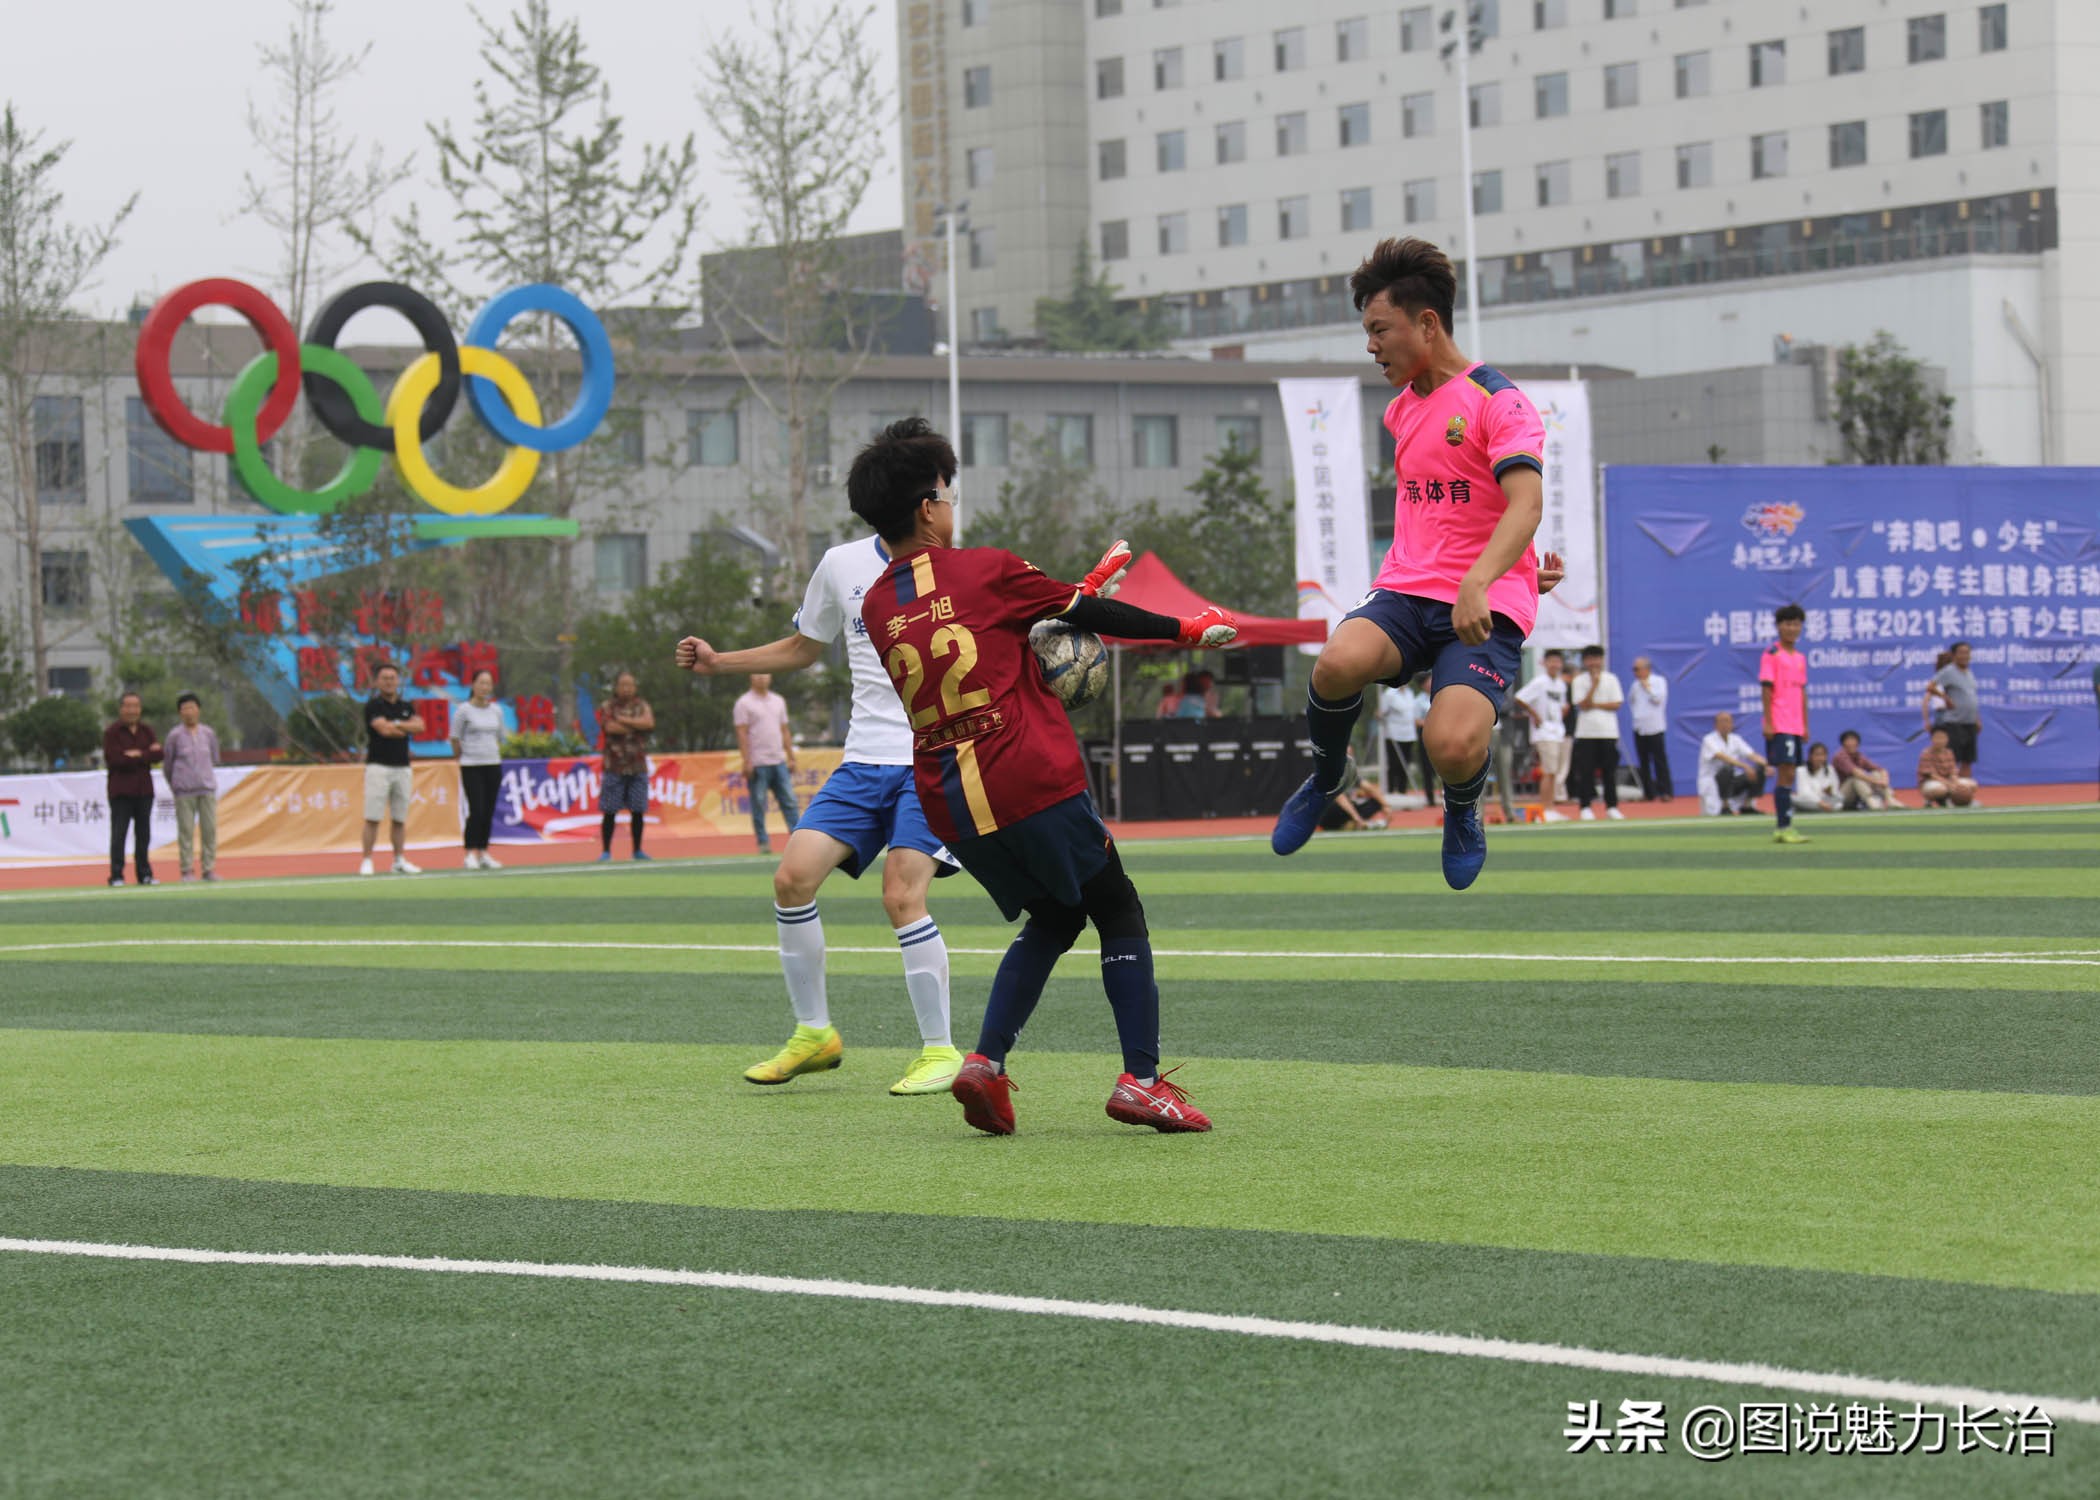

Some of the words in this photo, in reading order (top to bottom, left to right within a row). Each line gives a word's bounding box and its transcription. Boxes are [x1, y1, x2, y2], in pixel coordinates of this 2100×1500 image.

[886, 596, 955, 639] 李一旭
[889, 623, 991, 730] 22
[1468, 663, 1505, 688] KELME
